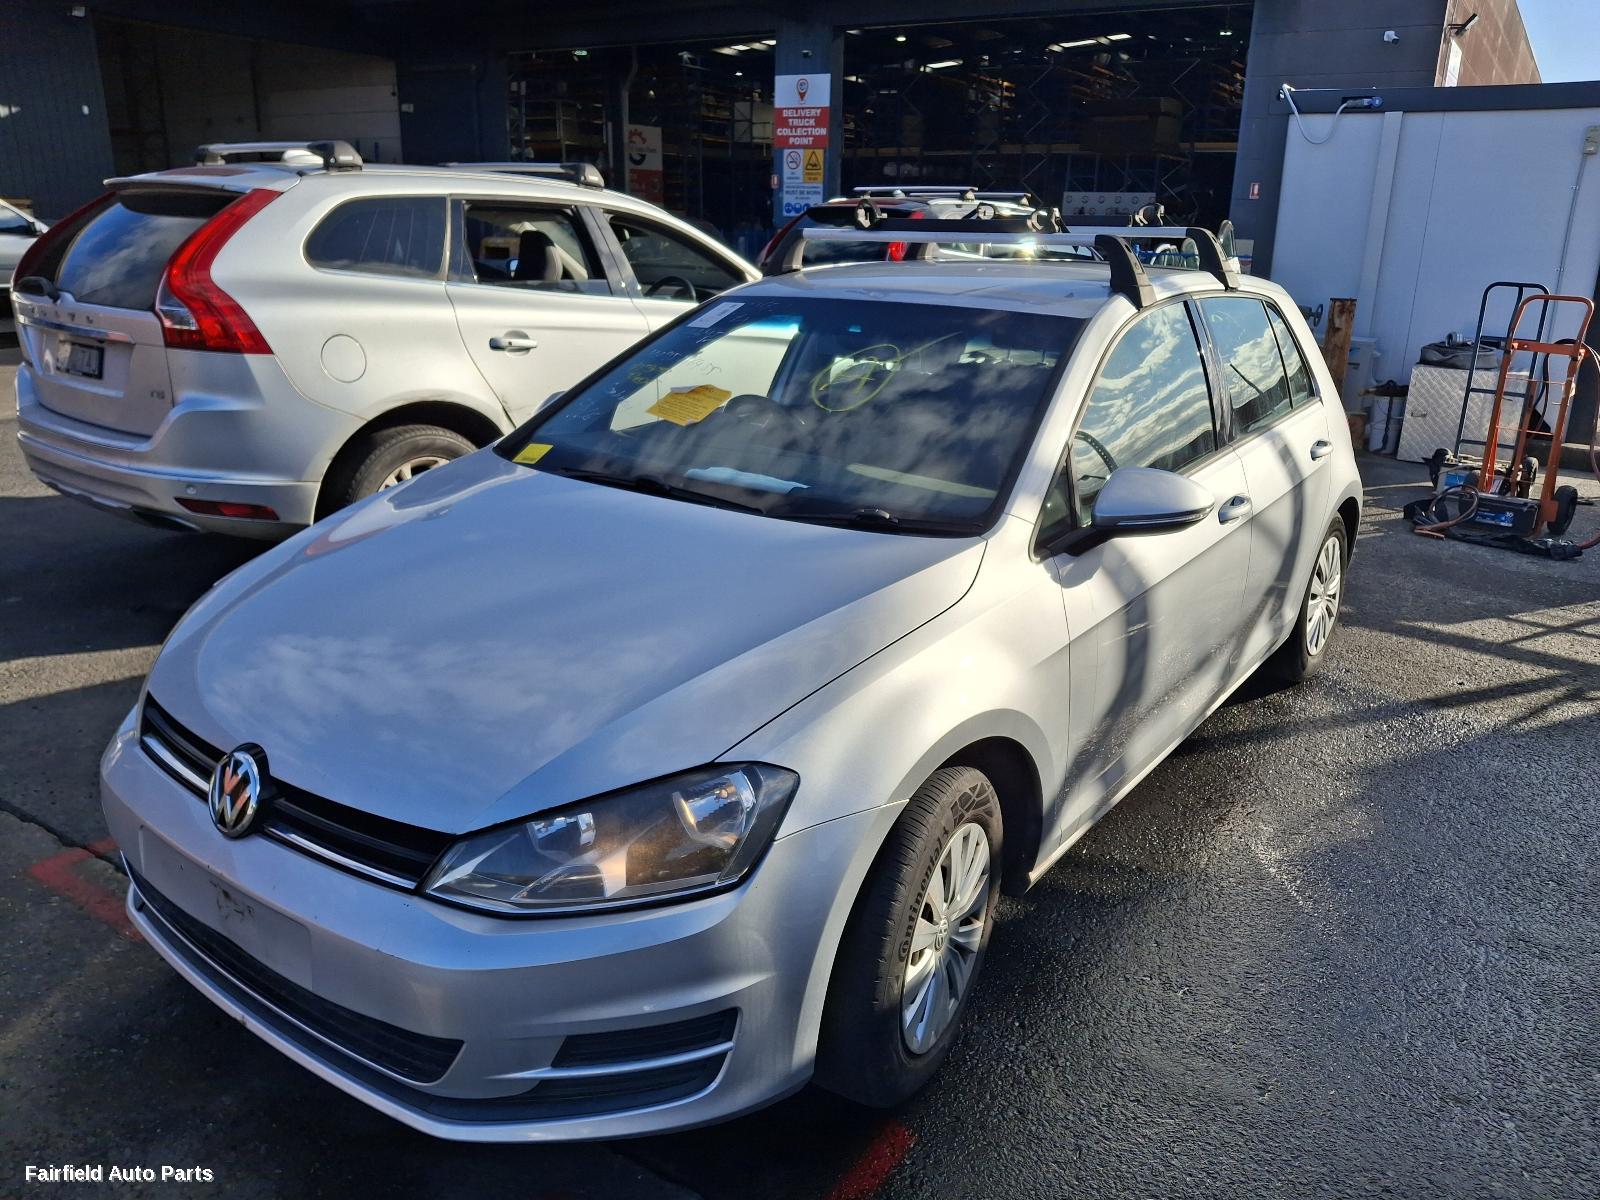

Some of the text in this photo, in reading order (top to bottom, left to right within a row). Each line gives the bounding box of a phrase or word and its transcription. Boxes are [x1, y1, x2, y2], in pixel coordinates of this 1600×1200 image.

[782, 108, 822, 117] DELIVERY
[788, 118, 816, 127] TRUCK
[776, 127, 827, 136] COLLECTION
[789, 137, 814, 145] POINT
[899, 836, 944, 963] Continental
